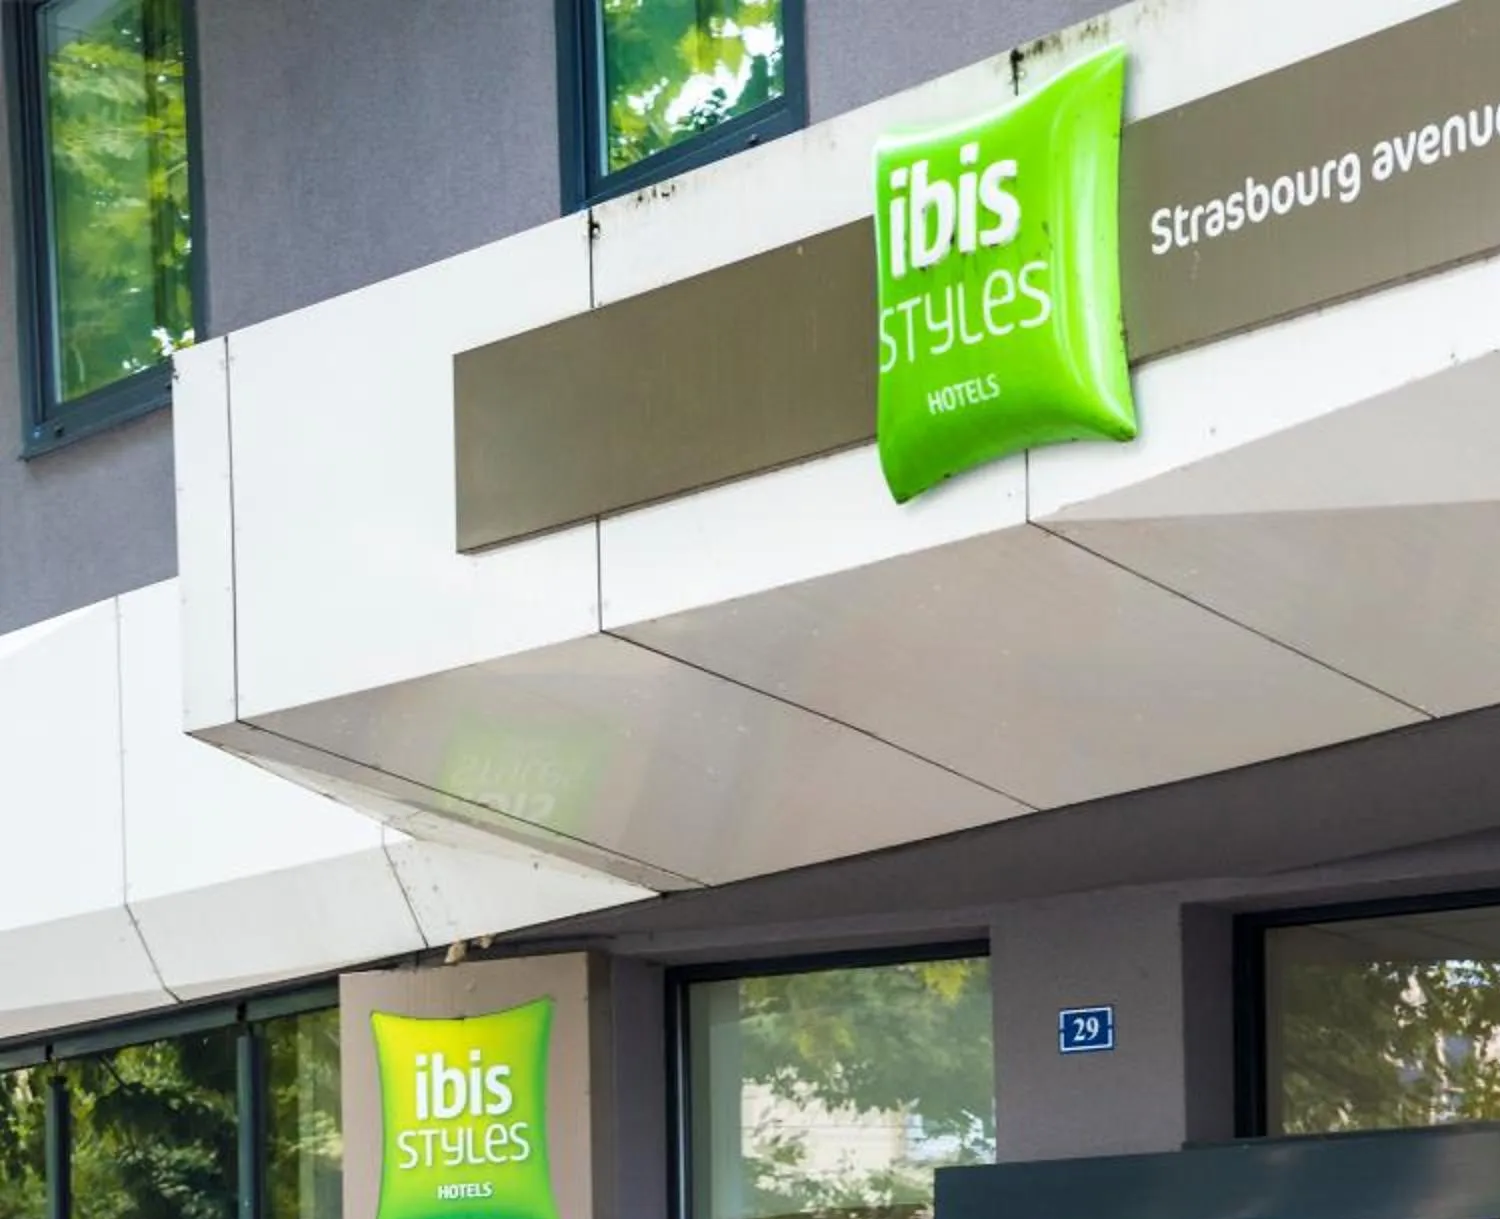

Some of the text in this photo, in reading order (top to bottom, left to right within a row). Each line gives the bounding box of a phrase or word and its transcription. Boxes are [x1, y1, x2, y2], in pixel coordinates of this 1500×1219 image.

[889, 142, 1021, 279] ibis
[1150, 152, 1361, 255] Strasbourg
[928, 373, 999, 415] HOTELS
[1073, 1016, 1099, 1041] 29
[415, 1047, 513, 1121] ibis
[437, 1182, 494, 1200] HOTELS
